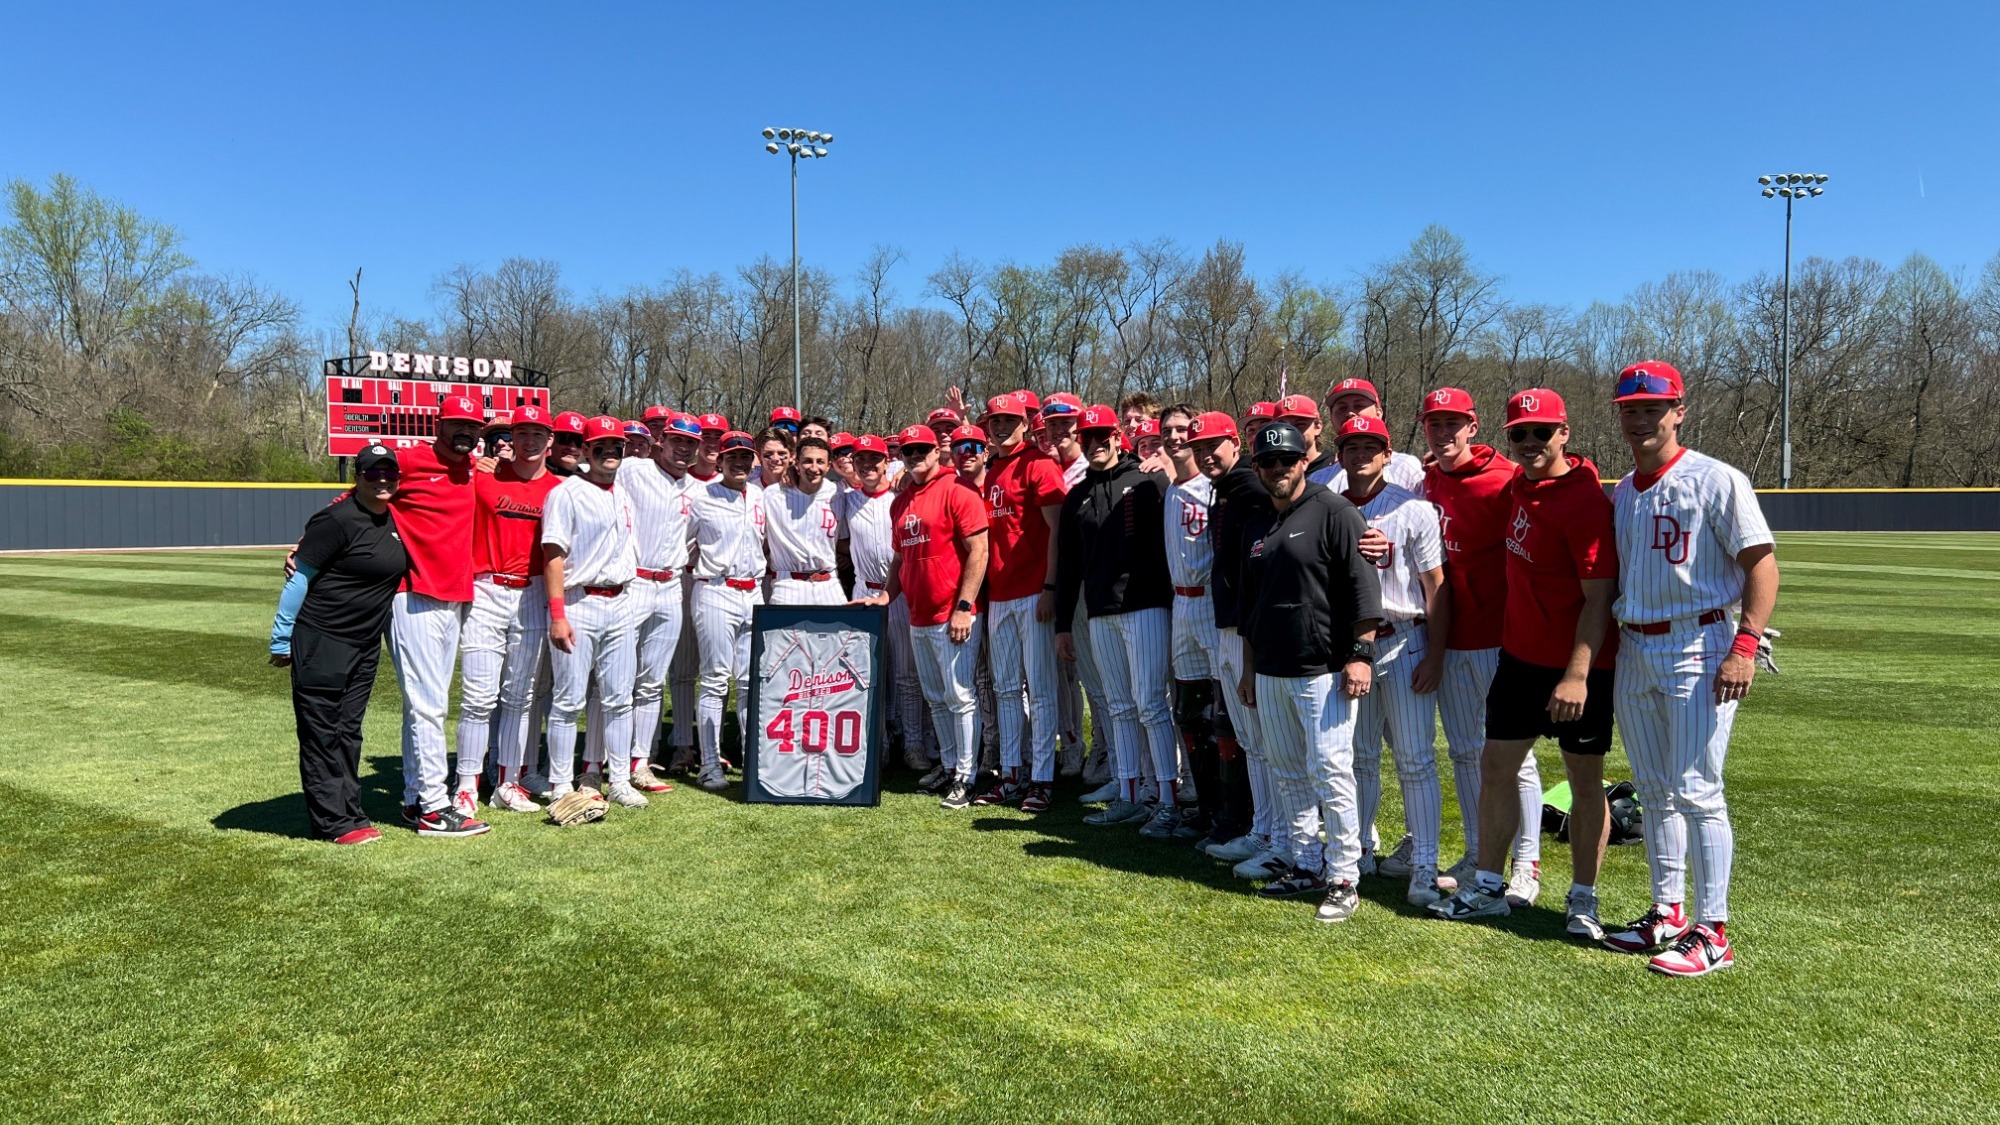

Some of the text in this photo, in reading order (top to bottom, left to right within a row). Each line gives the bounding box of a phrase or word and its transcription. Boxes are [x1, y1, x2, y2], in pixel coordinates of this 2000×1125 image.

[369, 350, 512, 379] DENISON
[996, 397, 1008, 409] DU
[1284, 397, 1297, 411] DU
[1434, 390, 1451, 405] DU
[1520, 394, 1540, 412] DU
[460, 398, 473, 412] DU
[525, 406, 538, 420] DU
[1085, 411, 1098, 424] DU
[344, 424, 369, 433] DENISON
[570, 416, 582, 430] DU
[601, 418, 614, 431] DU
[1141, 421, 1153, 432] DU
[1192, 419, 1205, 433] DU
[1353, 417, 1369, 431] DU
[907, 427, 919, 438] DU
[961, 426, 972, 436] DU
[1266, 429, 1284, 446] DU
[860, 436, 872, 447] DU
[990, 484, 1004, 508] DU
[905, 514, 922, 536] DU
[1181, 501, 1205, 536] DU
[1512, 506, 1531, 543] DU
[1651, 515, 1692, 565] DU
[788, 667, 855, 692] Denison
[815, 686, 832, 696] RED
[766, 707, 862, 757] 400
